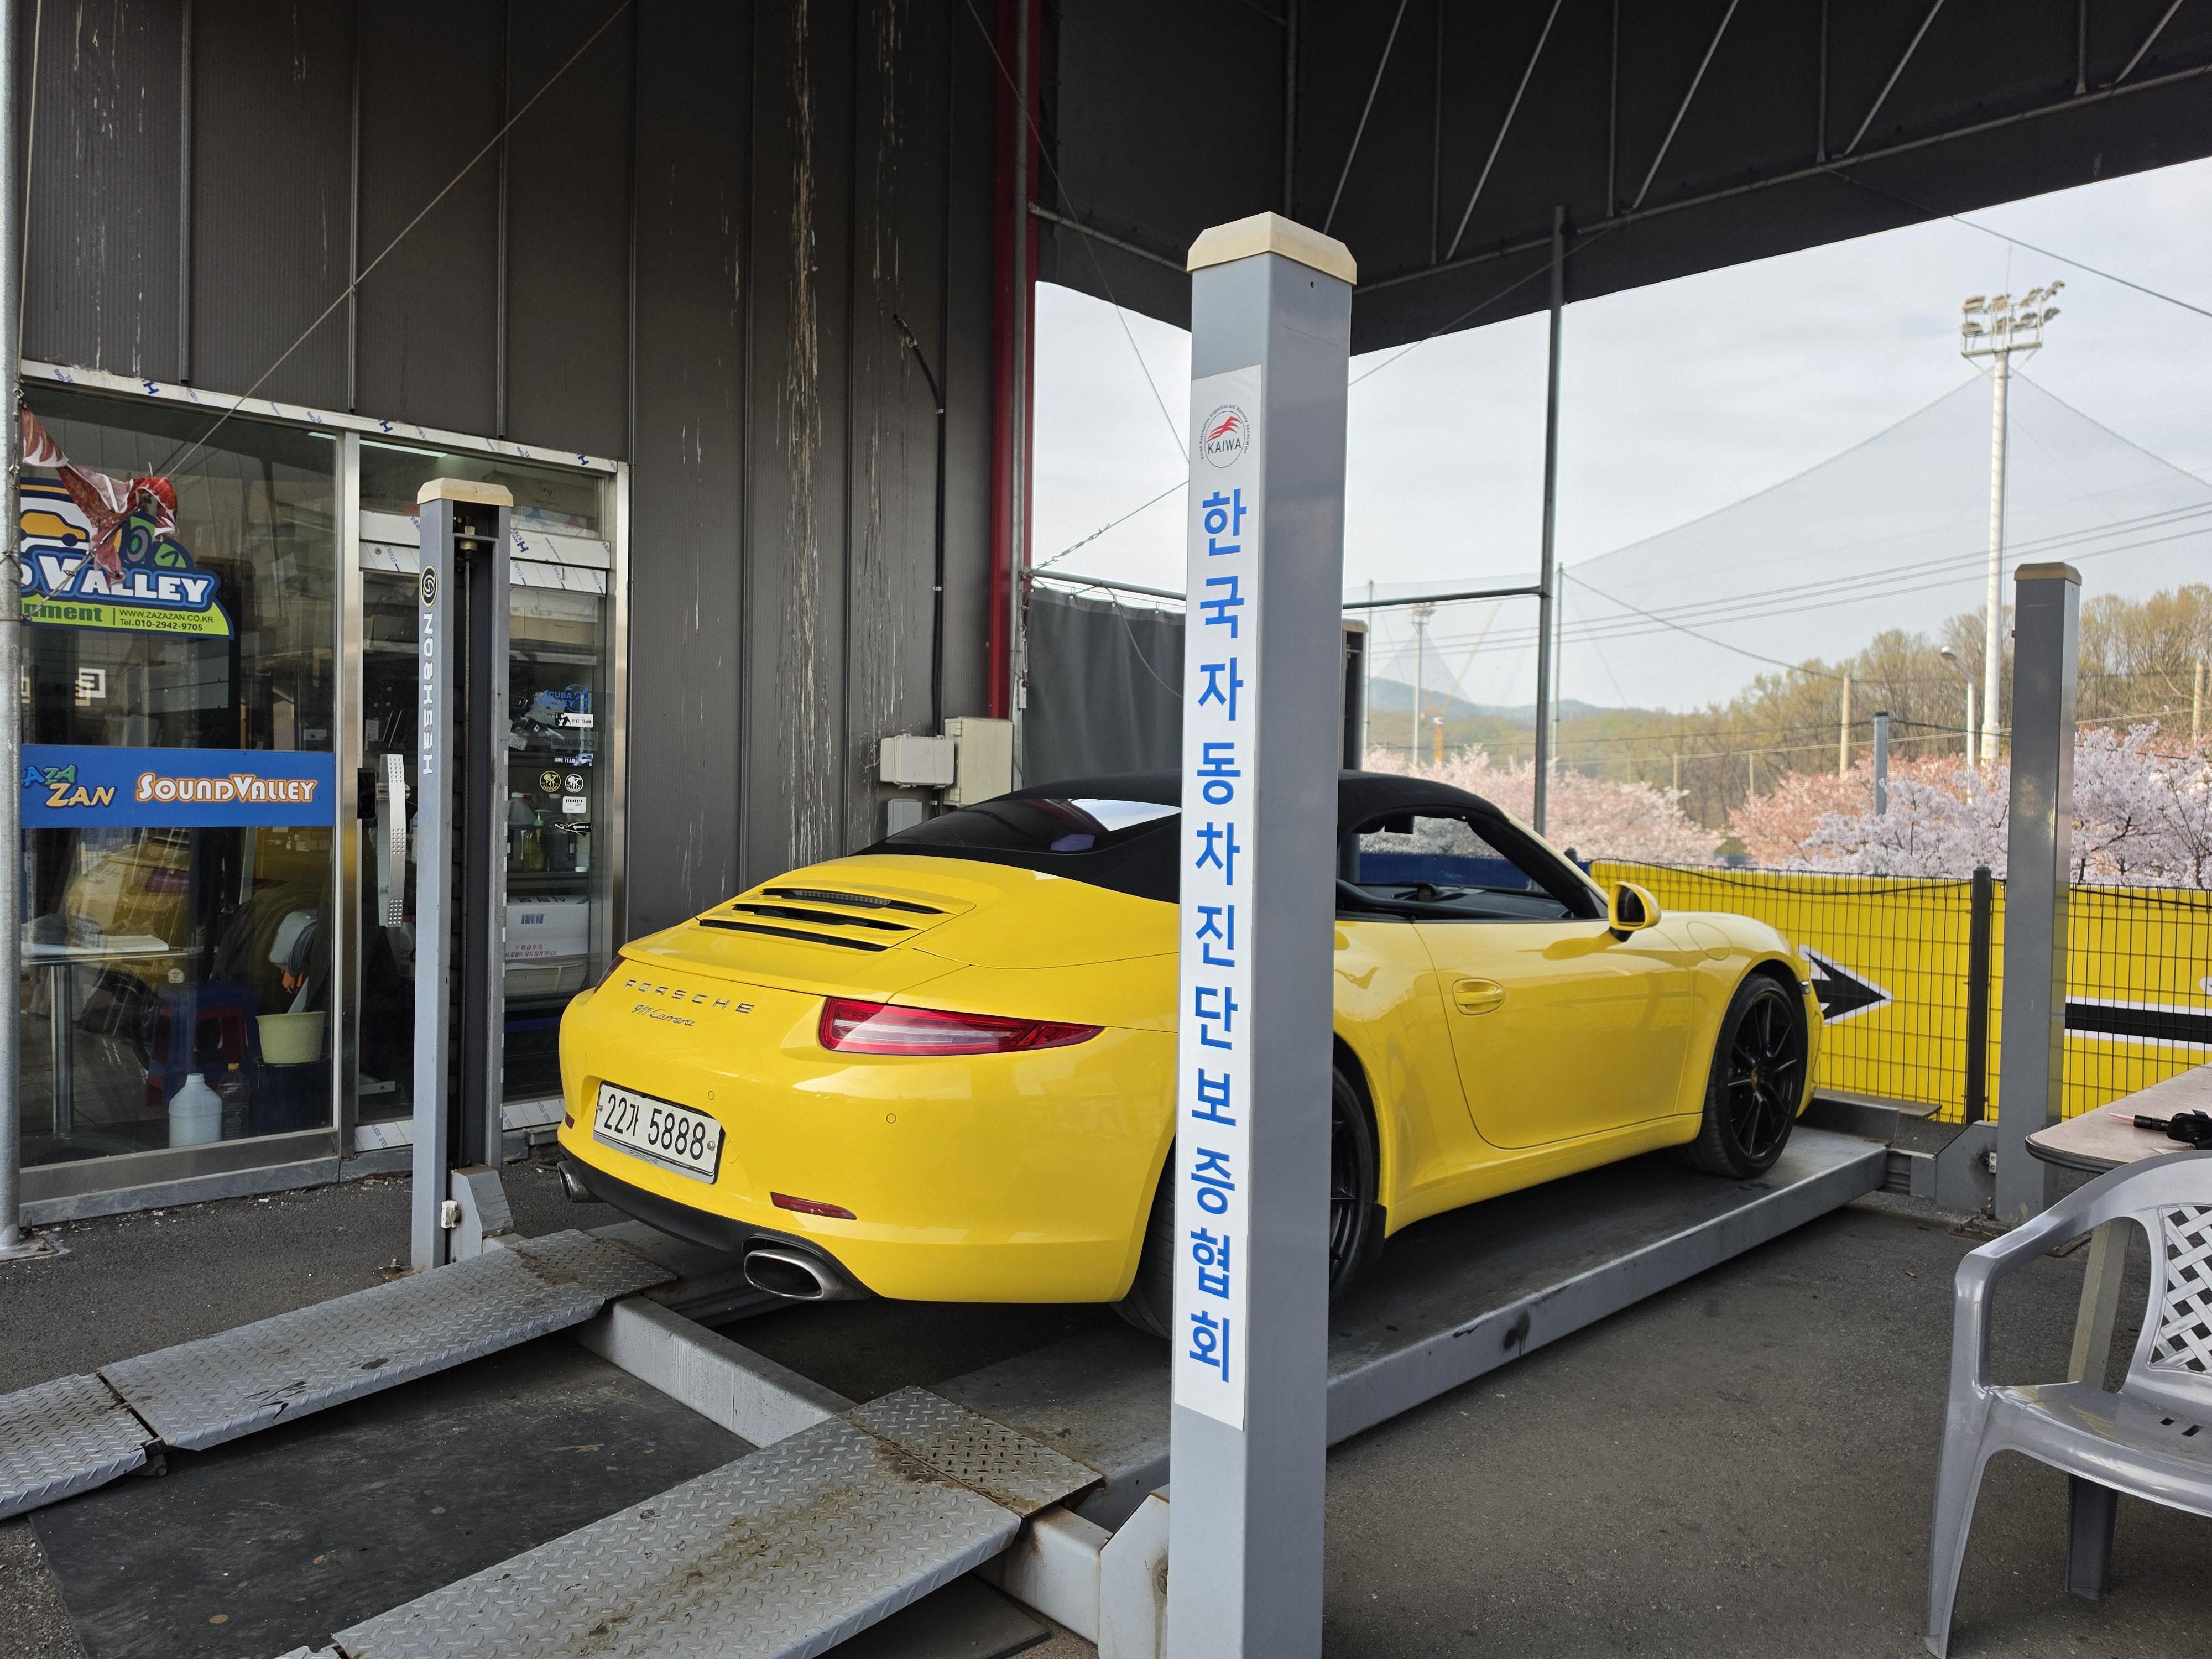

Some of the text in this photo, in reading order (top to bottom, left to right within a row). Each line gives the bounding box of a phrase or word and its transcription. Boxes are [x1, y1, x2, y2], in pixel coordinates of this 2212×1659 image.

[1199, 418, 1211, 444] Automotive
[1207, 437, 1242, 455] KAIWA
[24, 603, 103, 623] nment
[119, 609, 214, 623] WWW.ZAZAZAN.CO.KR
[554, 738, 596, 747] SUUNTO
[21, 765, 76, 786] AZA
[46, 782, 115, 807] ZAN
[1189, 488, 1247, 1383] 한국자동차진단보증협회
[624, 979, 756, 1015] PORSCHE
[604, 1093, 706, 1160] 22가 5888
[629, 1149, 659, 1165] PORSCHE
